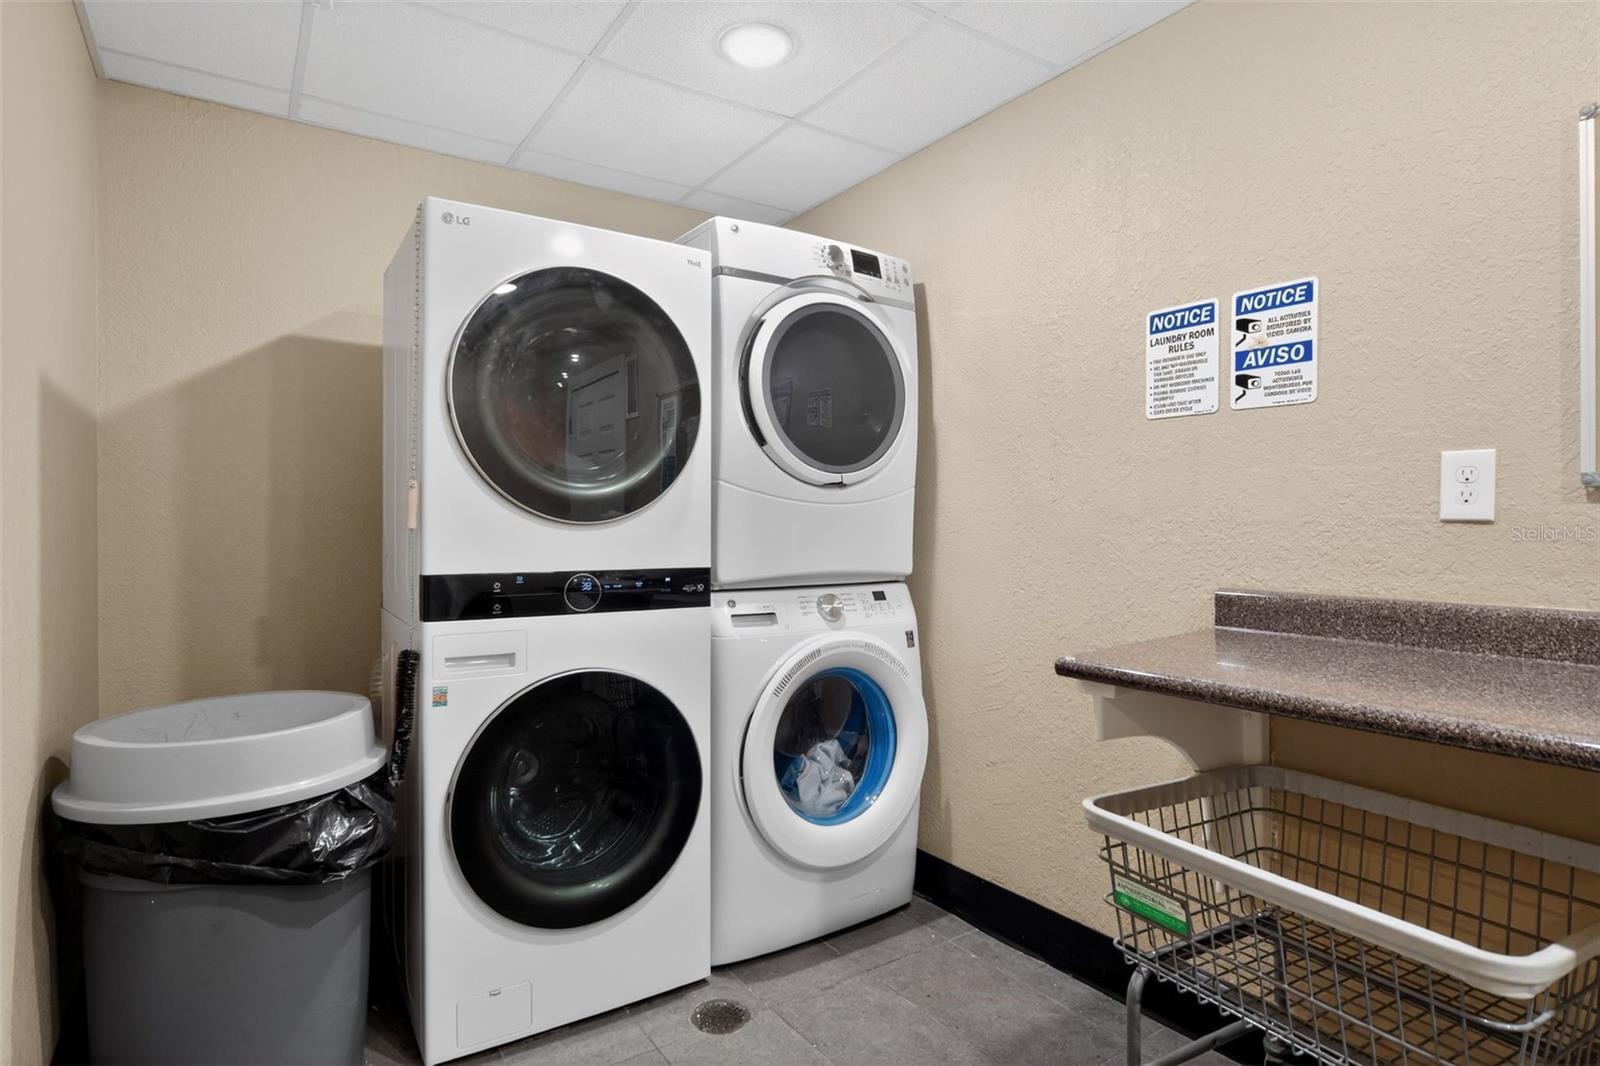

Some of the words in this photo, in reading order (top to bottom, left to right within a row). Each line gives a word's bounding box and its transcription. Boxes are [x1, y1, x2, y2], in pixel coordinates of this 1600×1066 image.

[456, 215, 471, 226] LG
[1241, 285, 1308, 313] NOTICE
[1151, 305, 1213, 332] NOTICE
[1149, 332, 1188, 348] LAUNDRY
[1188, 327, 1215, 340] ROOM
[1168, 341, 1195, 354] RULES
[1242, 344, 1305, 369] AVISO
